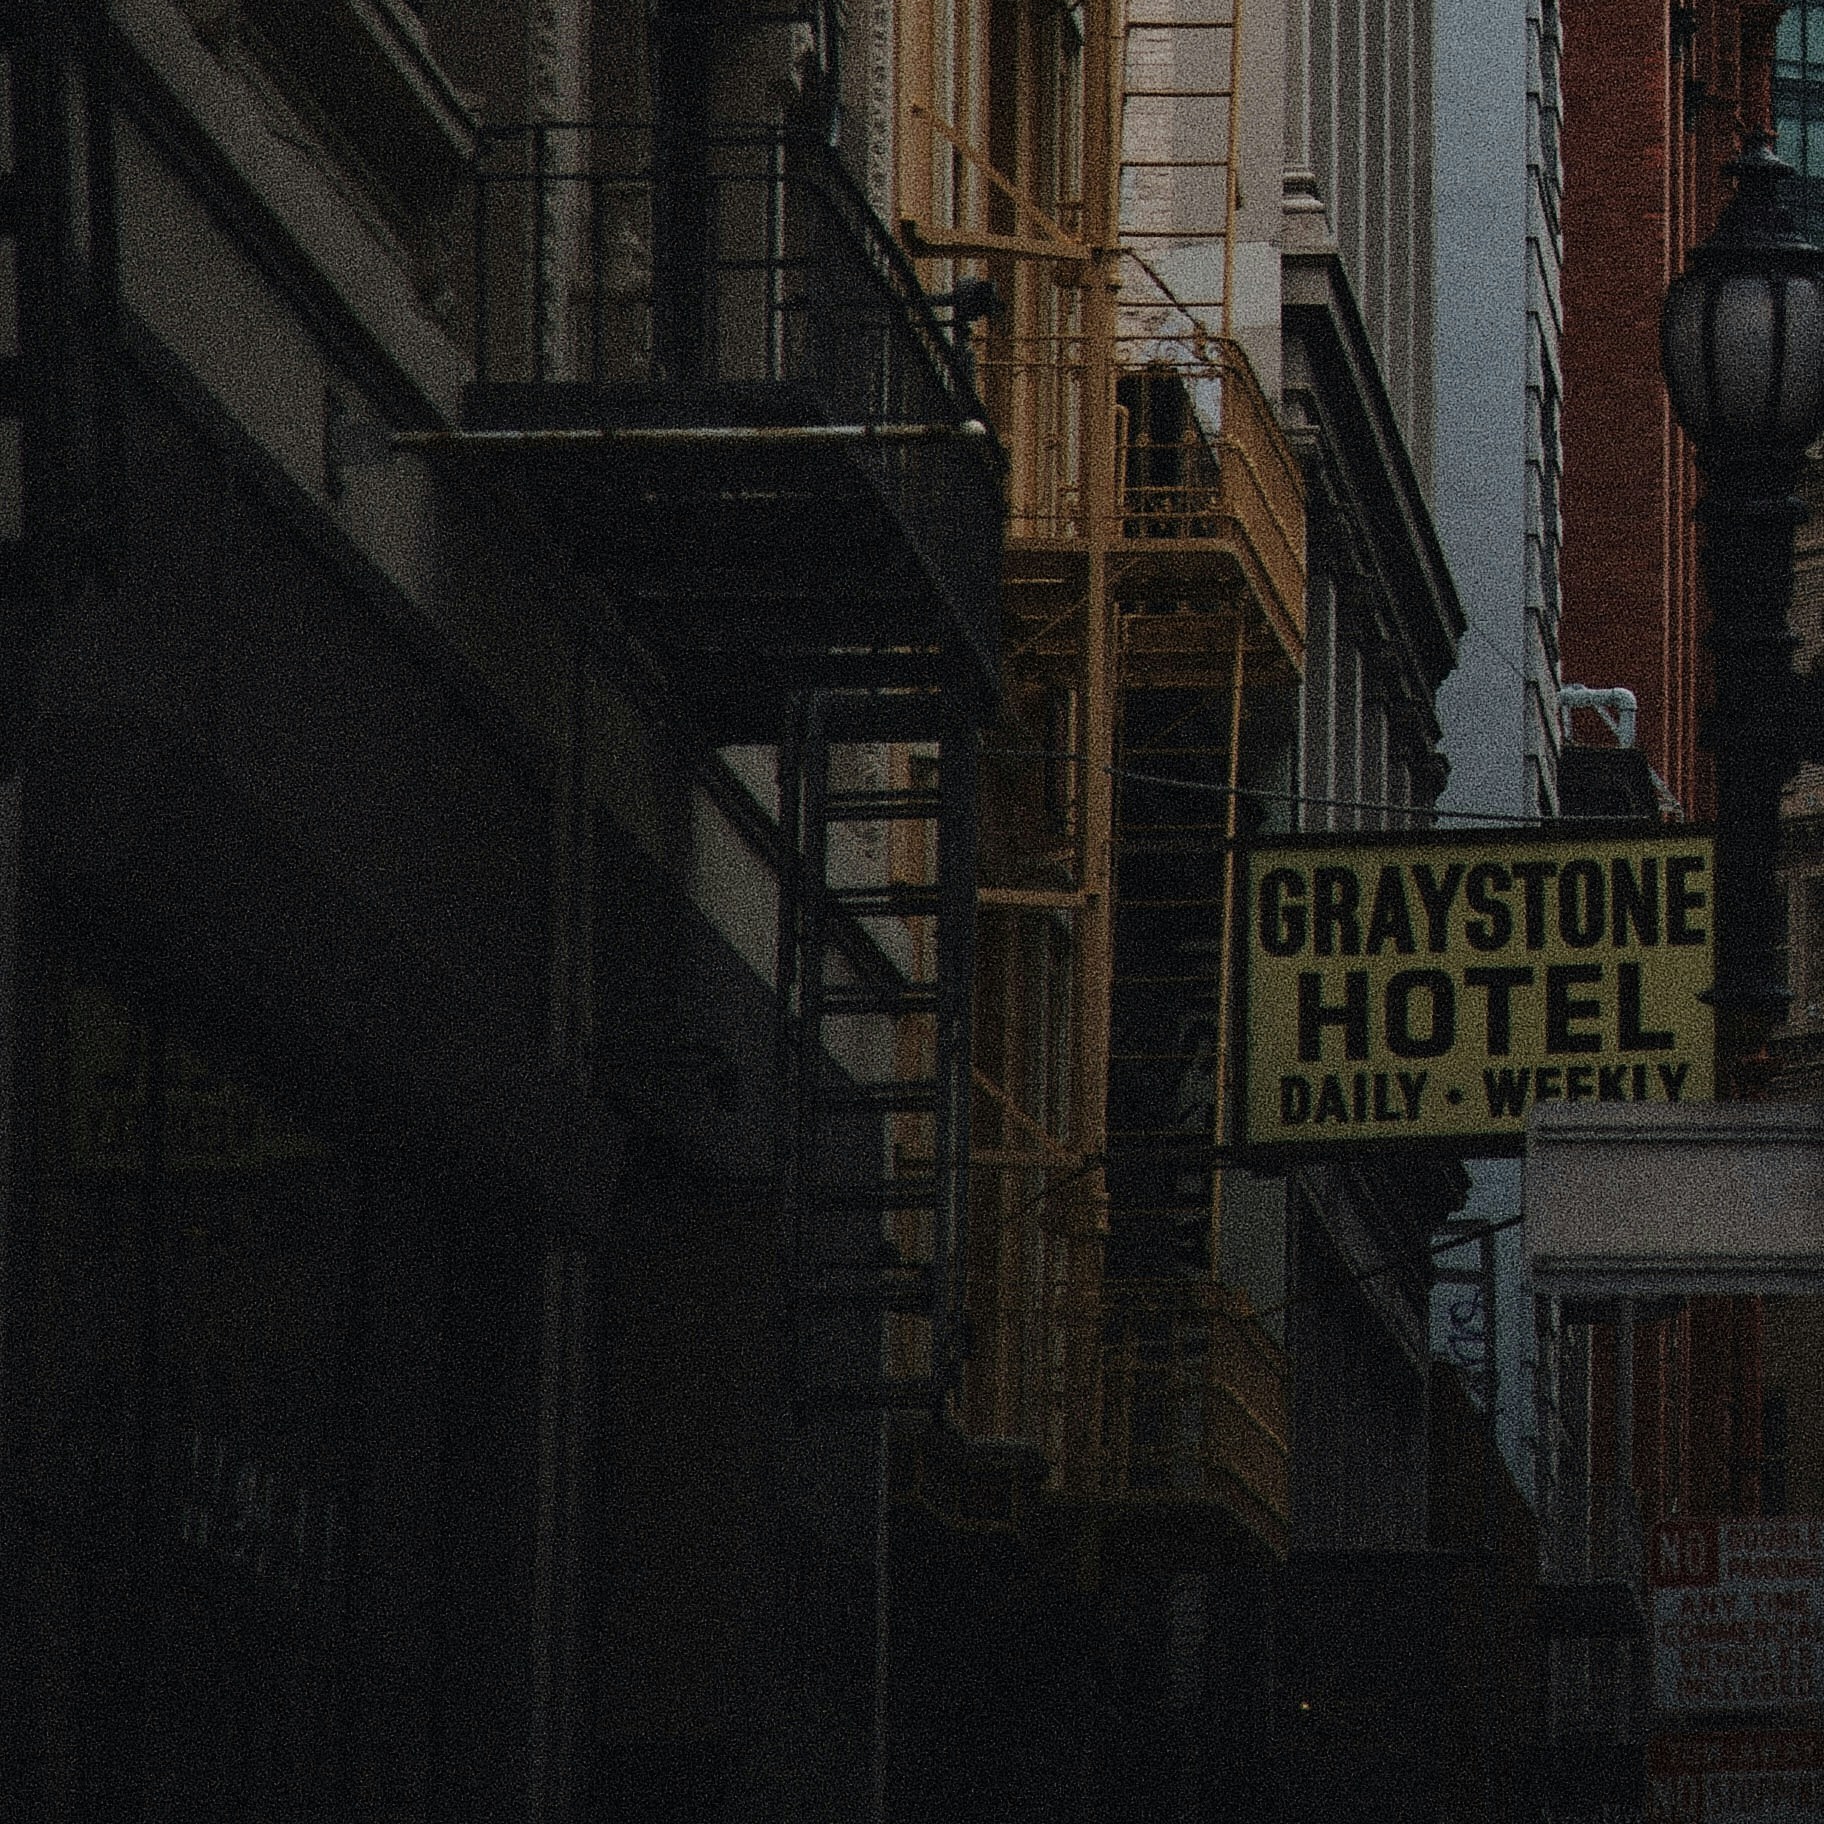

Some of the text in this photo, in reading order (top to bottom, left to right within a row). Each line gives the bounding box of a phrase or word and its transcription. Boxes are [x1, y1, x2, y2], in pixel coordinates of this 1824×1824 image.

[1259, 856, 1707, 957] GRAYSTONE
[1298, 962, 1675, 1062] HOTEL
[1281, 1062, 1691, 1125] DAILY WEEKLY
[1658, 1528, 1708, 1577] NO
[1680, 1588, 1812, 1615] ANY TIME
